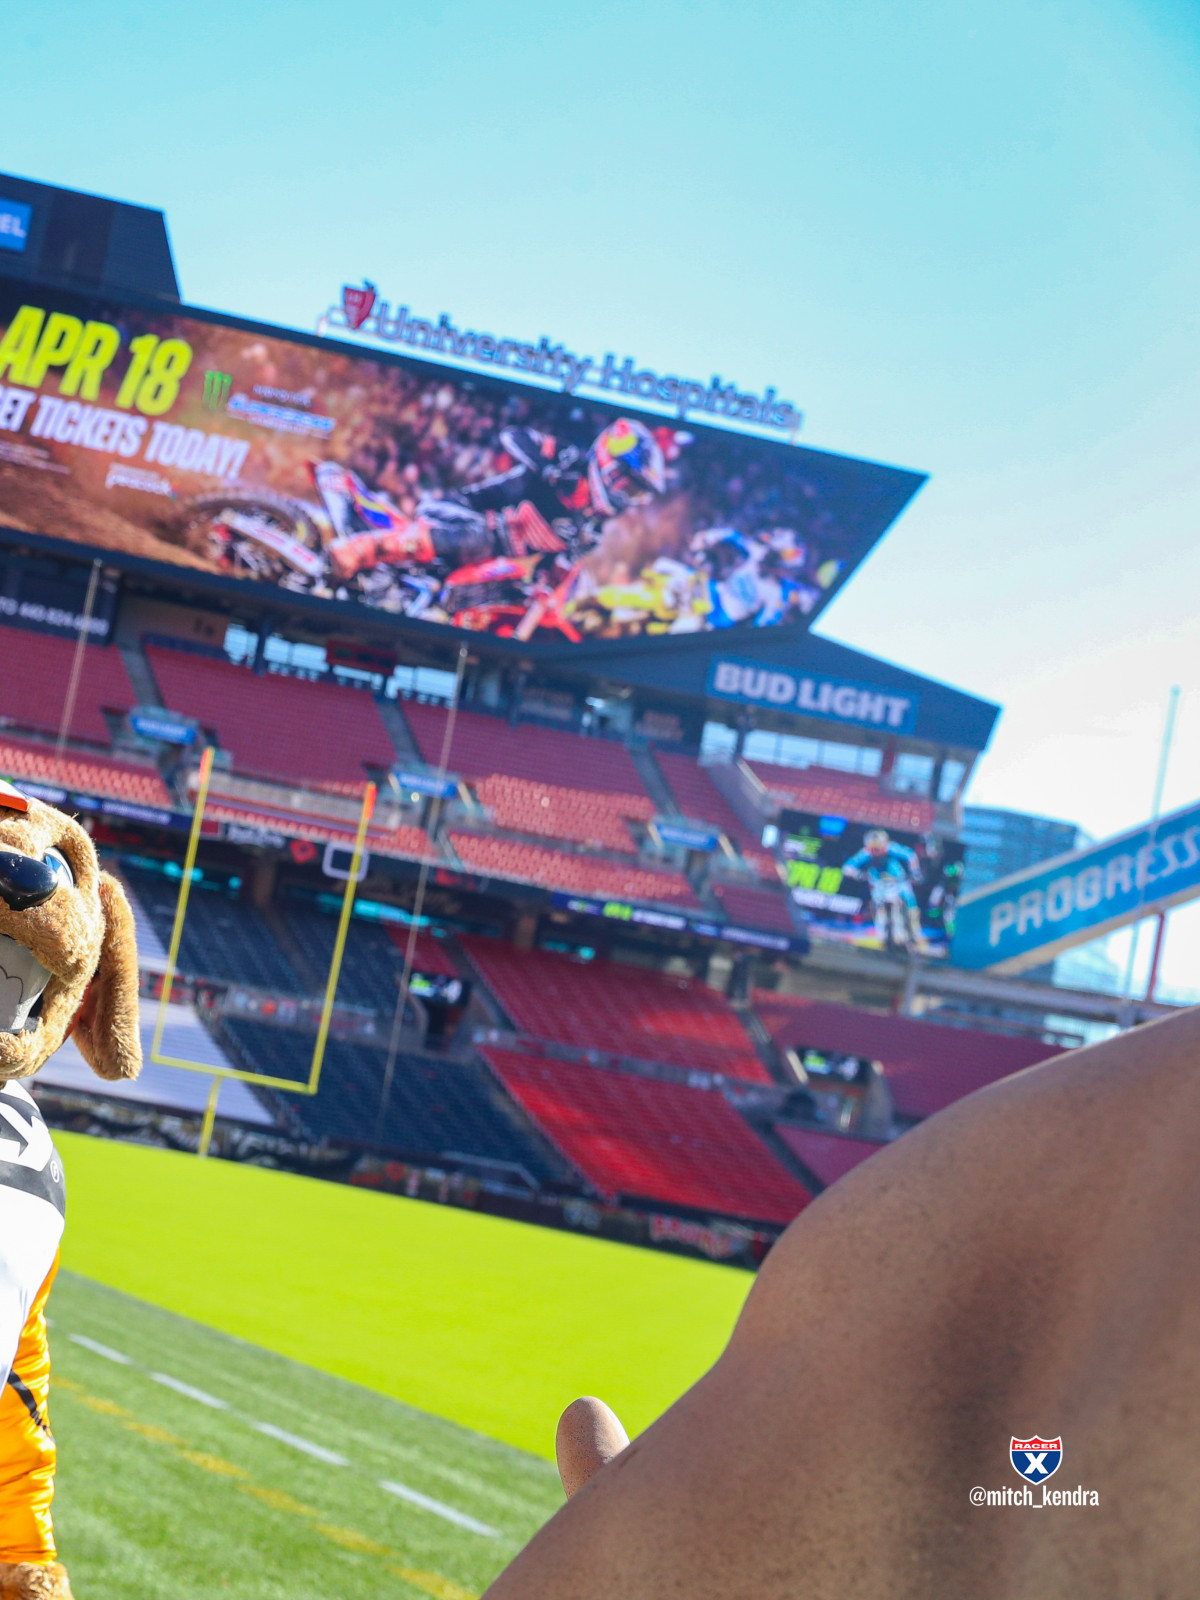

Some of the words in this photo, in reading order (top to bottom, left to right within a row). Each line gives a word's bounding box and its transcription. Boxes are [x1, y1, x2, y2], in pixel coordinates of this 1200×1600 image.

[114, 333, 194, 416] 18
[379, 301, 593, 396] University
[603, 353, 801, 430] Hospitals
[30, 394, 149, 458] TICKETS
[144, 421, 252, 480] TODAY!
[714, 661, 796, 705] BUD
[798, 678, 910, 728] LIGHT
